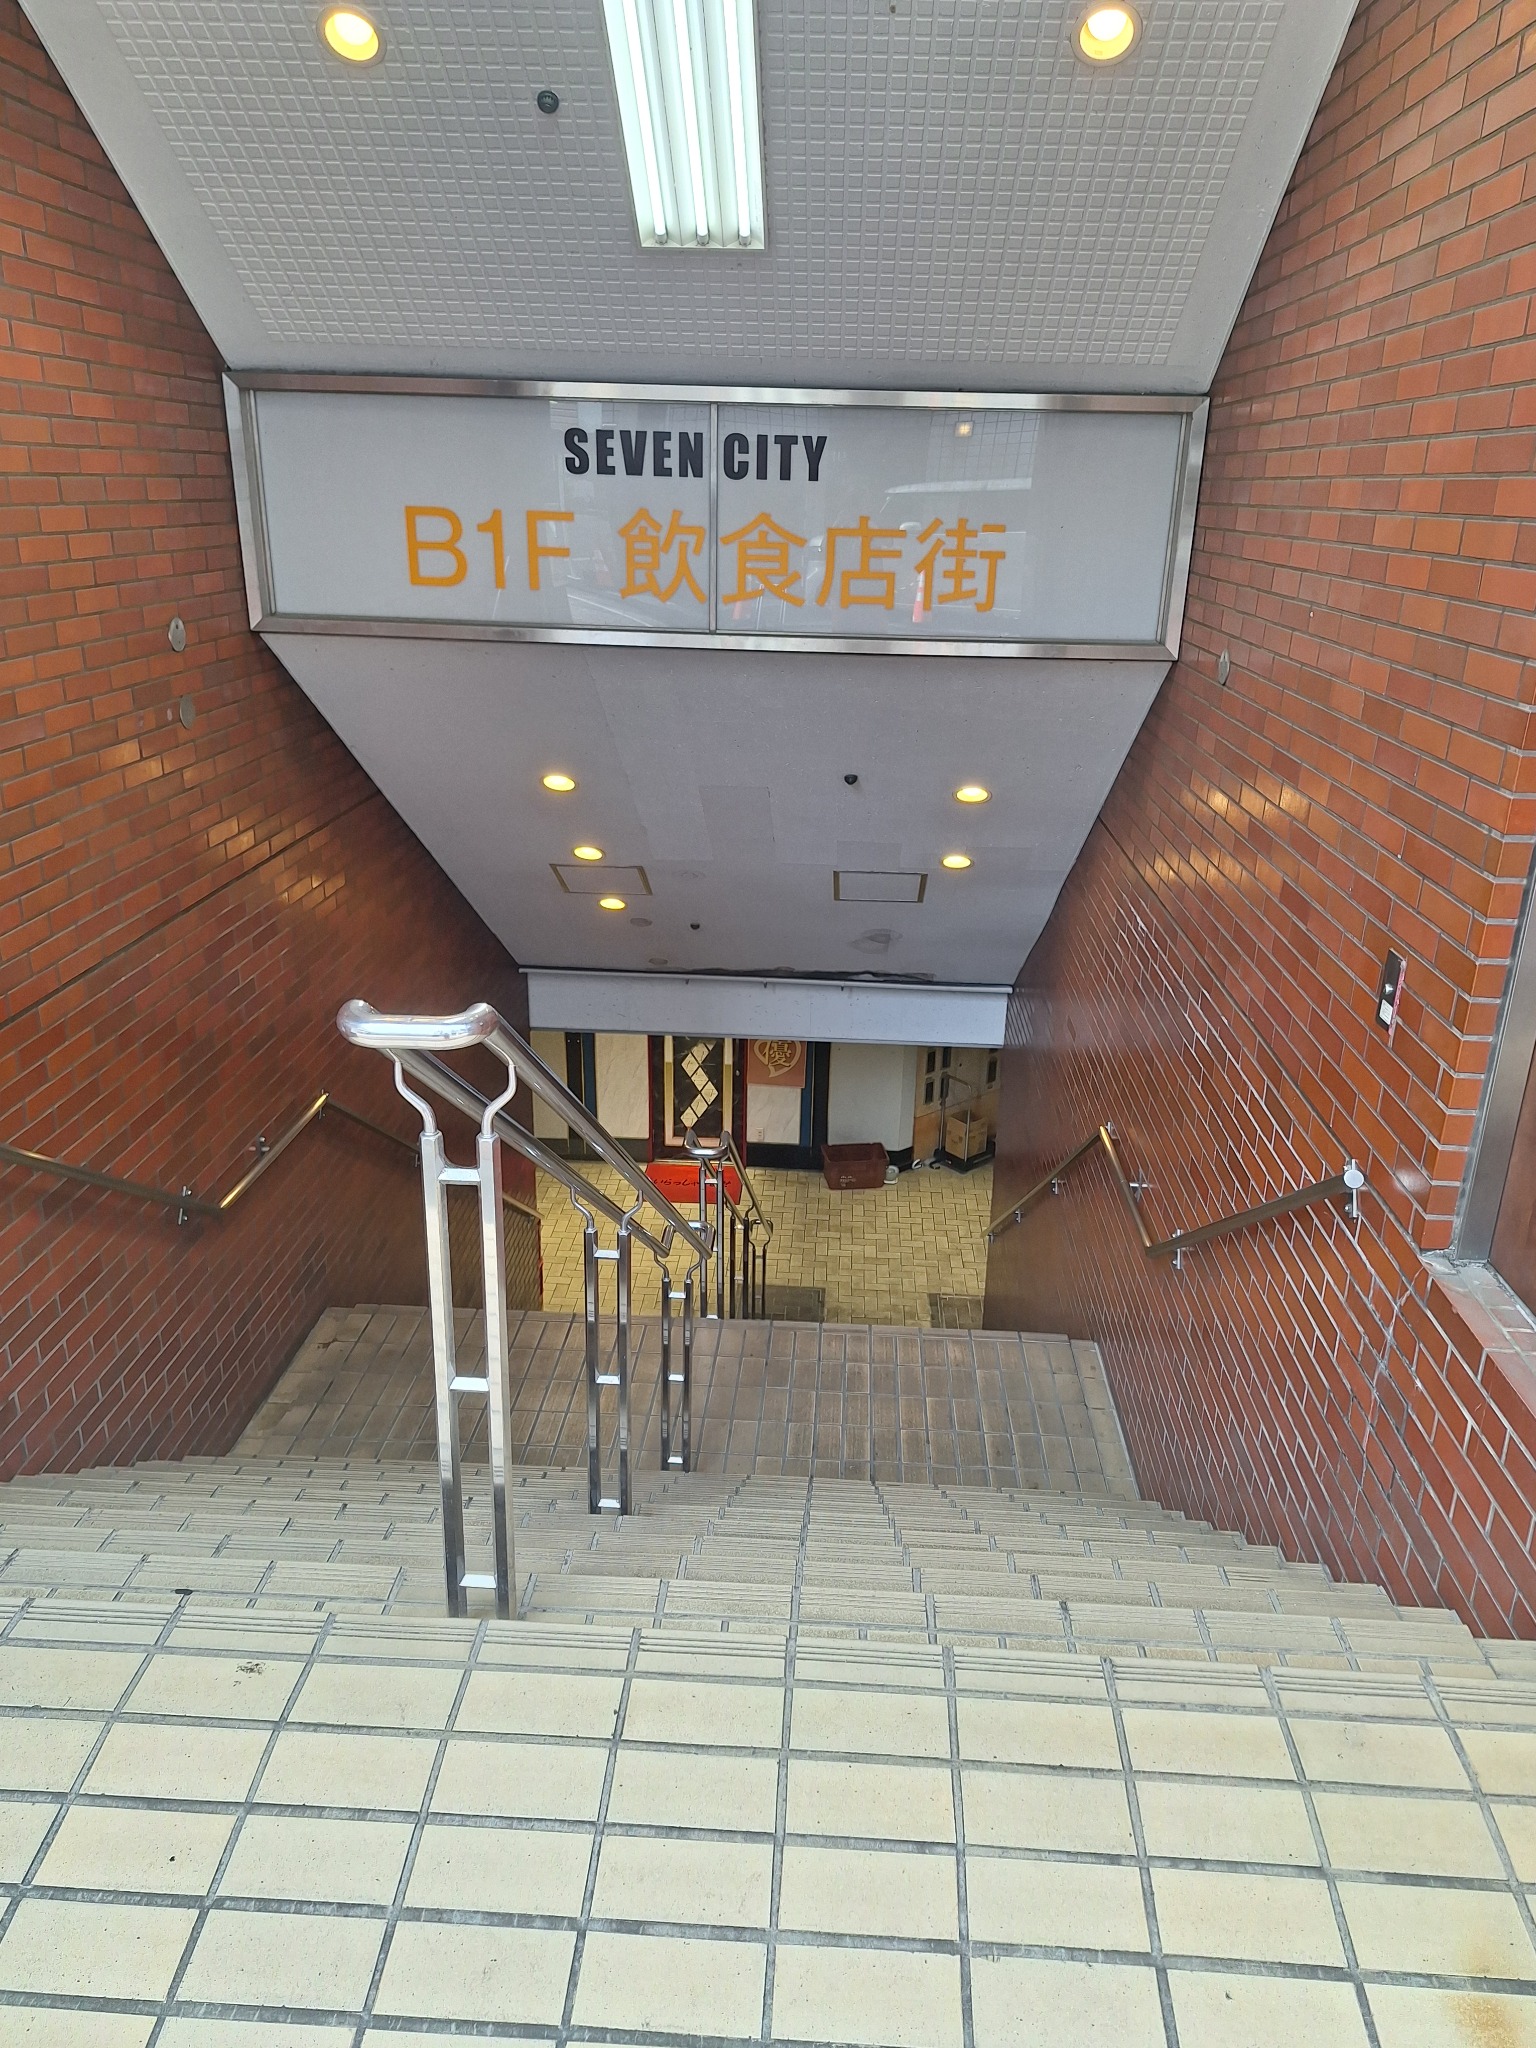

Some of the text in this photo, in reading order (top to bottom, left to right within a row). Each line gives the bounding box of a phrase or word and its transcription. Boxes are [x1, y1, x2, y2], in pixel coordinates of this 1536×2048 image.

[564, 427, 828, 482] SEVEN CITY
[404, 505, 1007, 612] B1F 飲食店街
